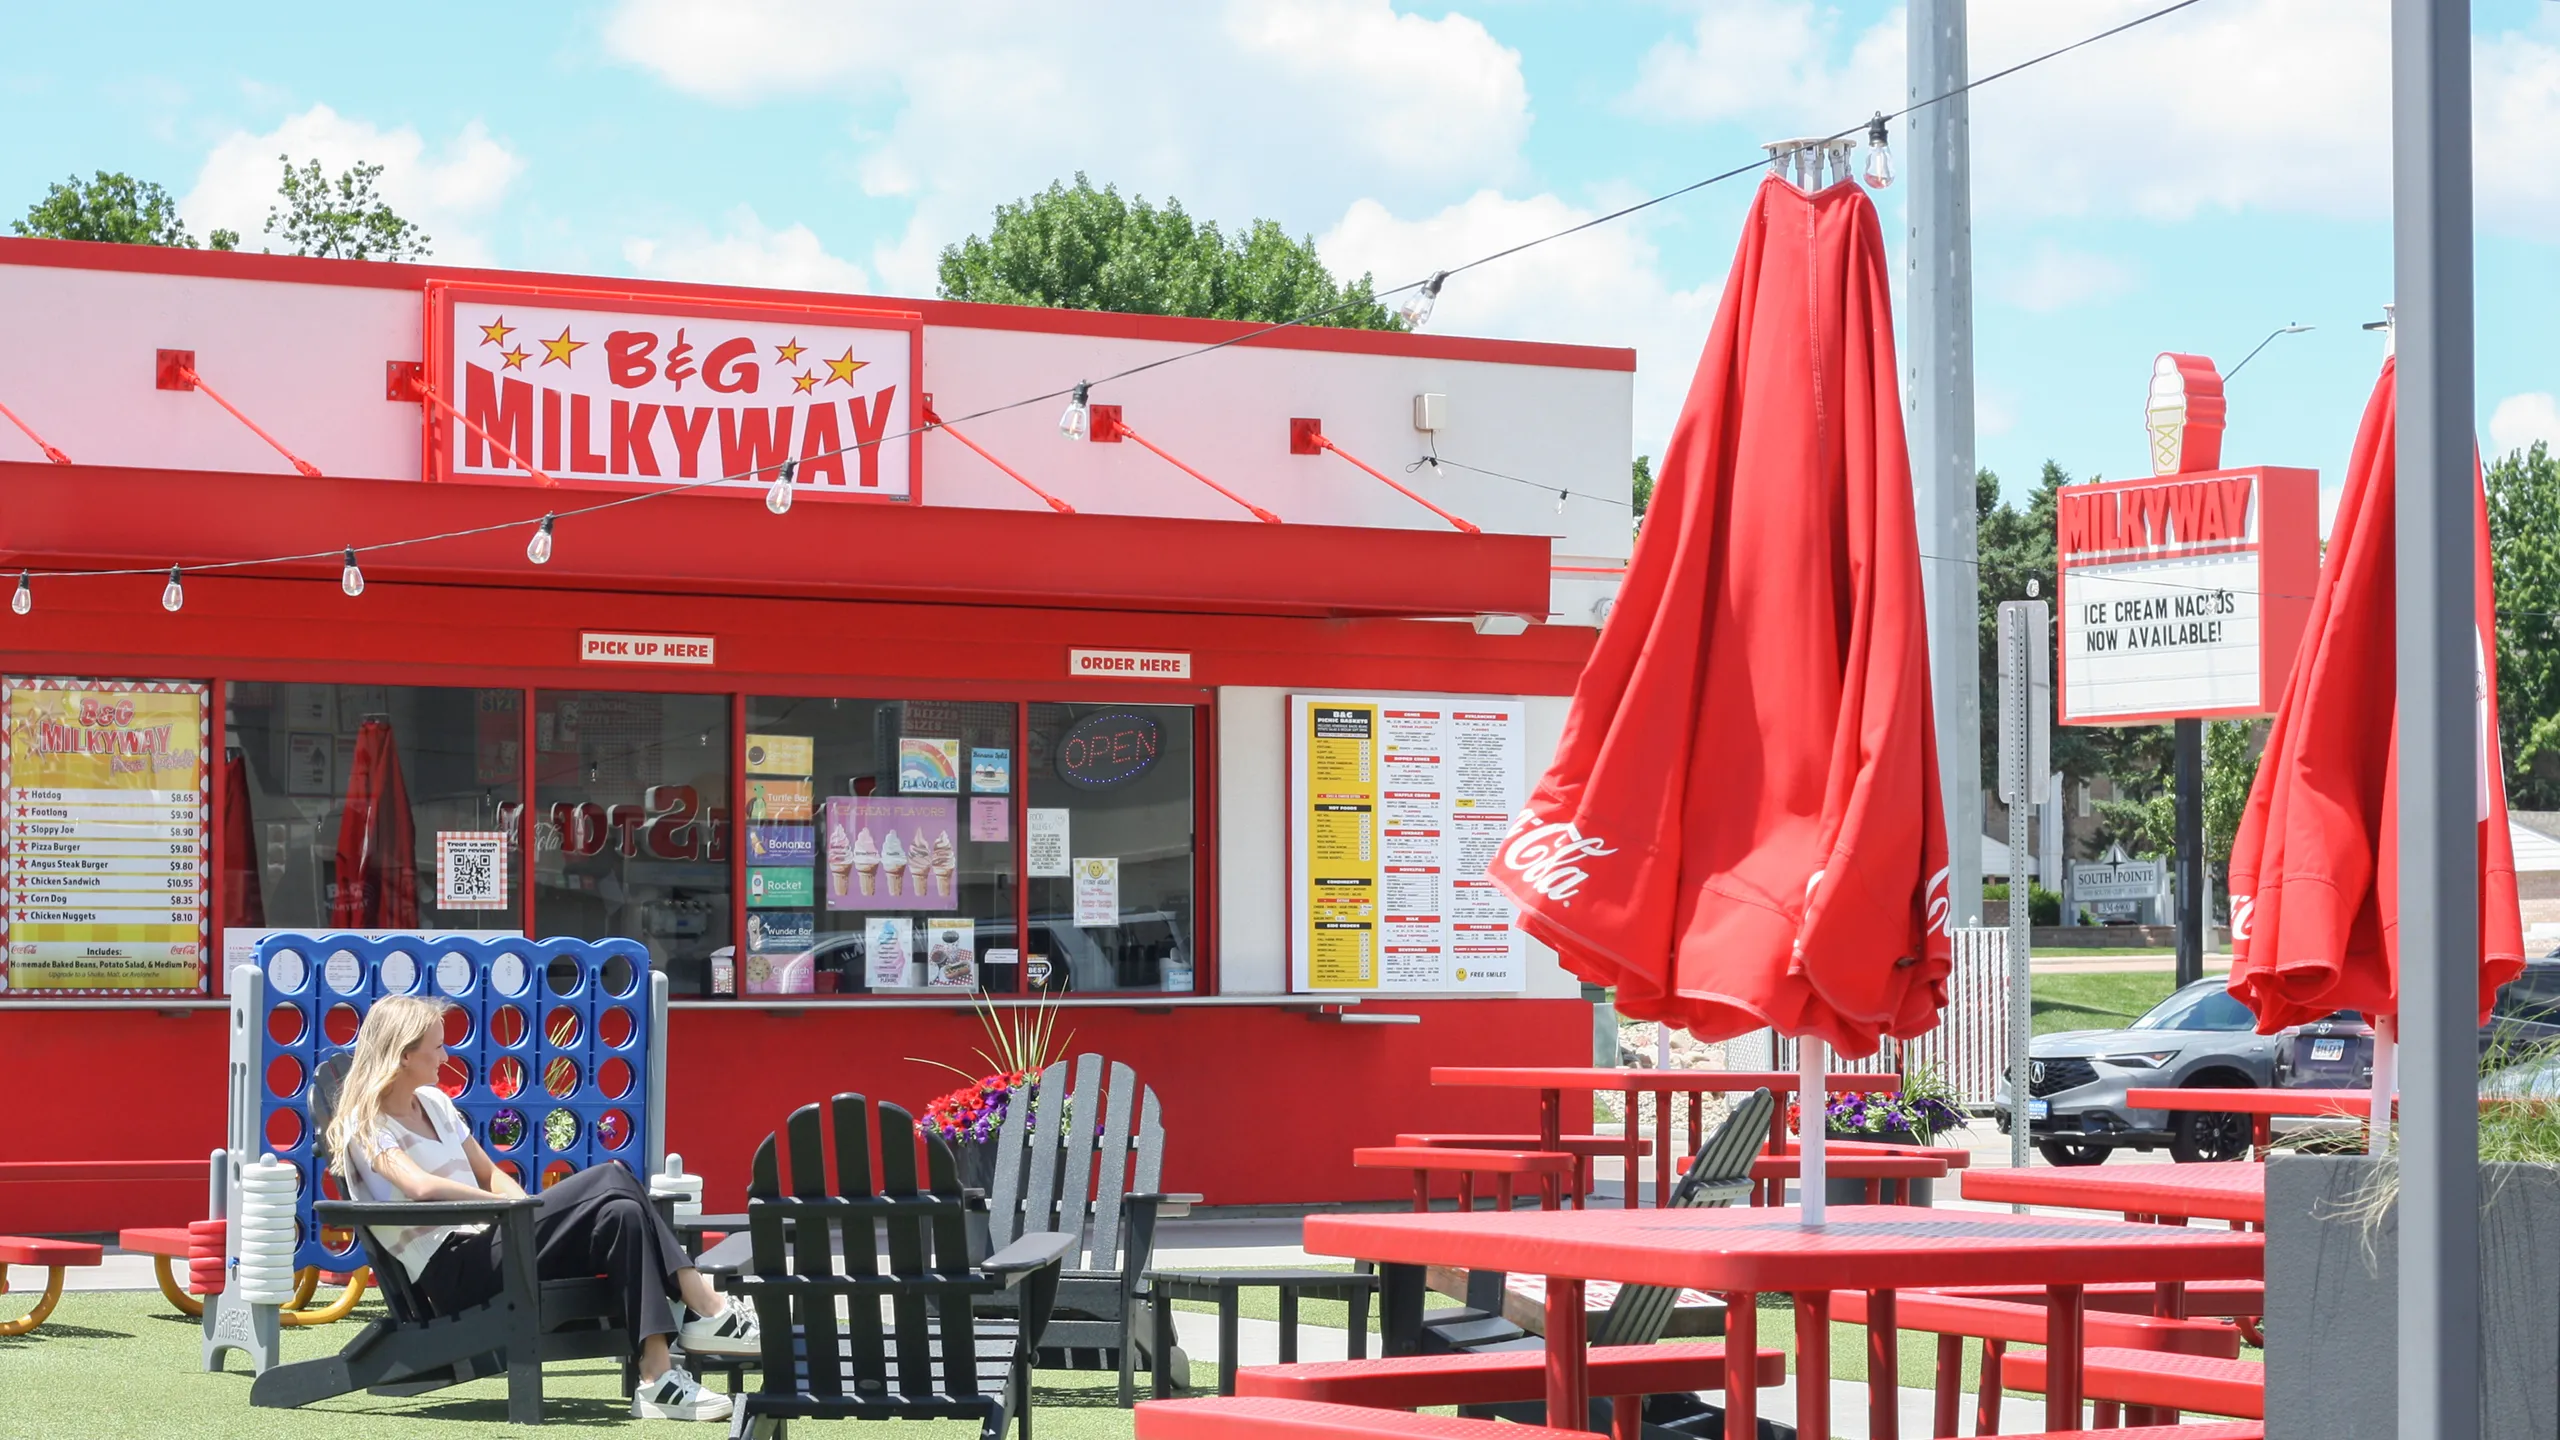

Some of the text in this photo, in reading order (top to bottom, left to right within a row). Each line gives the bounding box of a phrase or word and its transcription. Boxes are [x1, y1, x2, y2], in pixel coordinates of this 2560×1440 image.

[604, 328, 760, 394] B&G
[465, 361, 896, 488] MILKYWAY
[2064, 478, 2253, 553] MILKYWAY
[2084, 603, 2107, 625] ICE
[2115, 598, 2168, 622] CREAM
[2086, 621, 2222, 652] NOW AVAILABLE!
[588, 641, 708, 657] PICK UP HERE
[1081, 656, 1180, 672] ORDER HERE
[79, 698, 135, 726] B&G
[40, 720, 173, 755] MILKYWAY
[1066, 728, 1156, 769] OPEN
[32, 790, 194, 802] Hotdog $8.65
[768, 793, 792, 801] Turtle
[32, 808, 193, 819] Footlong $9.90
[894, 807, 946, 817] FLAVORS
[31, 825, 193, 837] Sloppy Joe $8.90
[31, 842, 193, 854] Pizza Burger $9.80
[769, 839, 811, 849] Bonanza
[31, 860, 193, 871] Angus Steak Burger $9.80
[31, 877, 193, 888] Chicken Sandwich $10.95
[2078, 870, 2154, 885] SOUTH POINTE
[768, 880, 802, 890] Rocket
[31, 895, 193, 905] Corn Dog $8.35
[31, 911, 192, 922] Chicken Nuggets $8.10
[87, 947, 122, 956] Includes:
[75, 961, 98, 969] Beans,
[100, 961, 124, 969] Potato
[125, 961, 147, 969] Salad,
[148, 961, 153, 969] &
[155, 961, 182, 969] Medium
[183, 961, 197, 970] Pop
